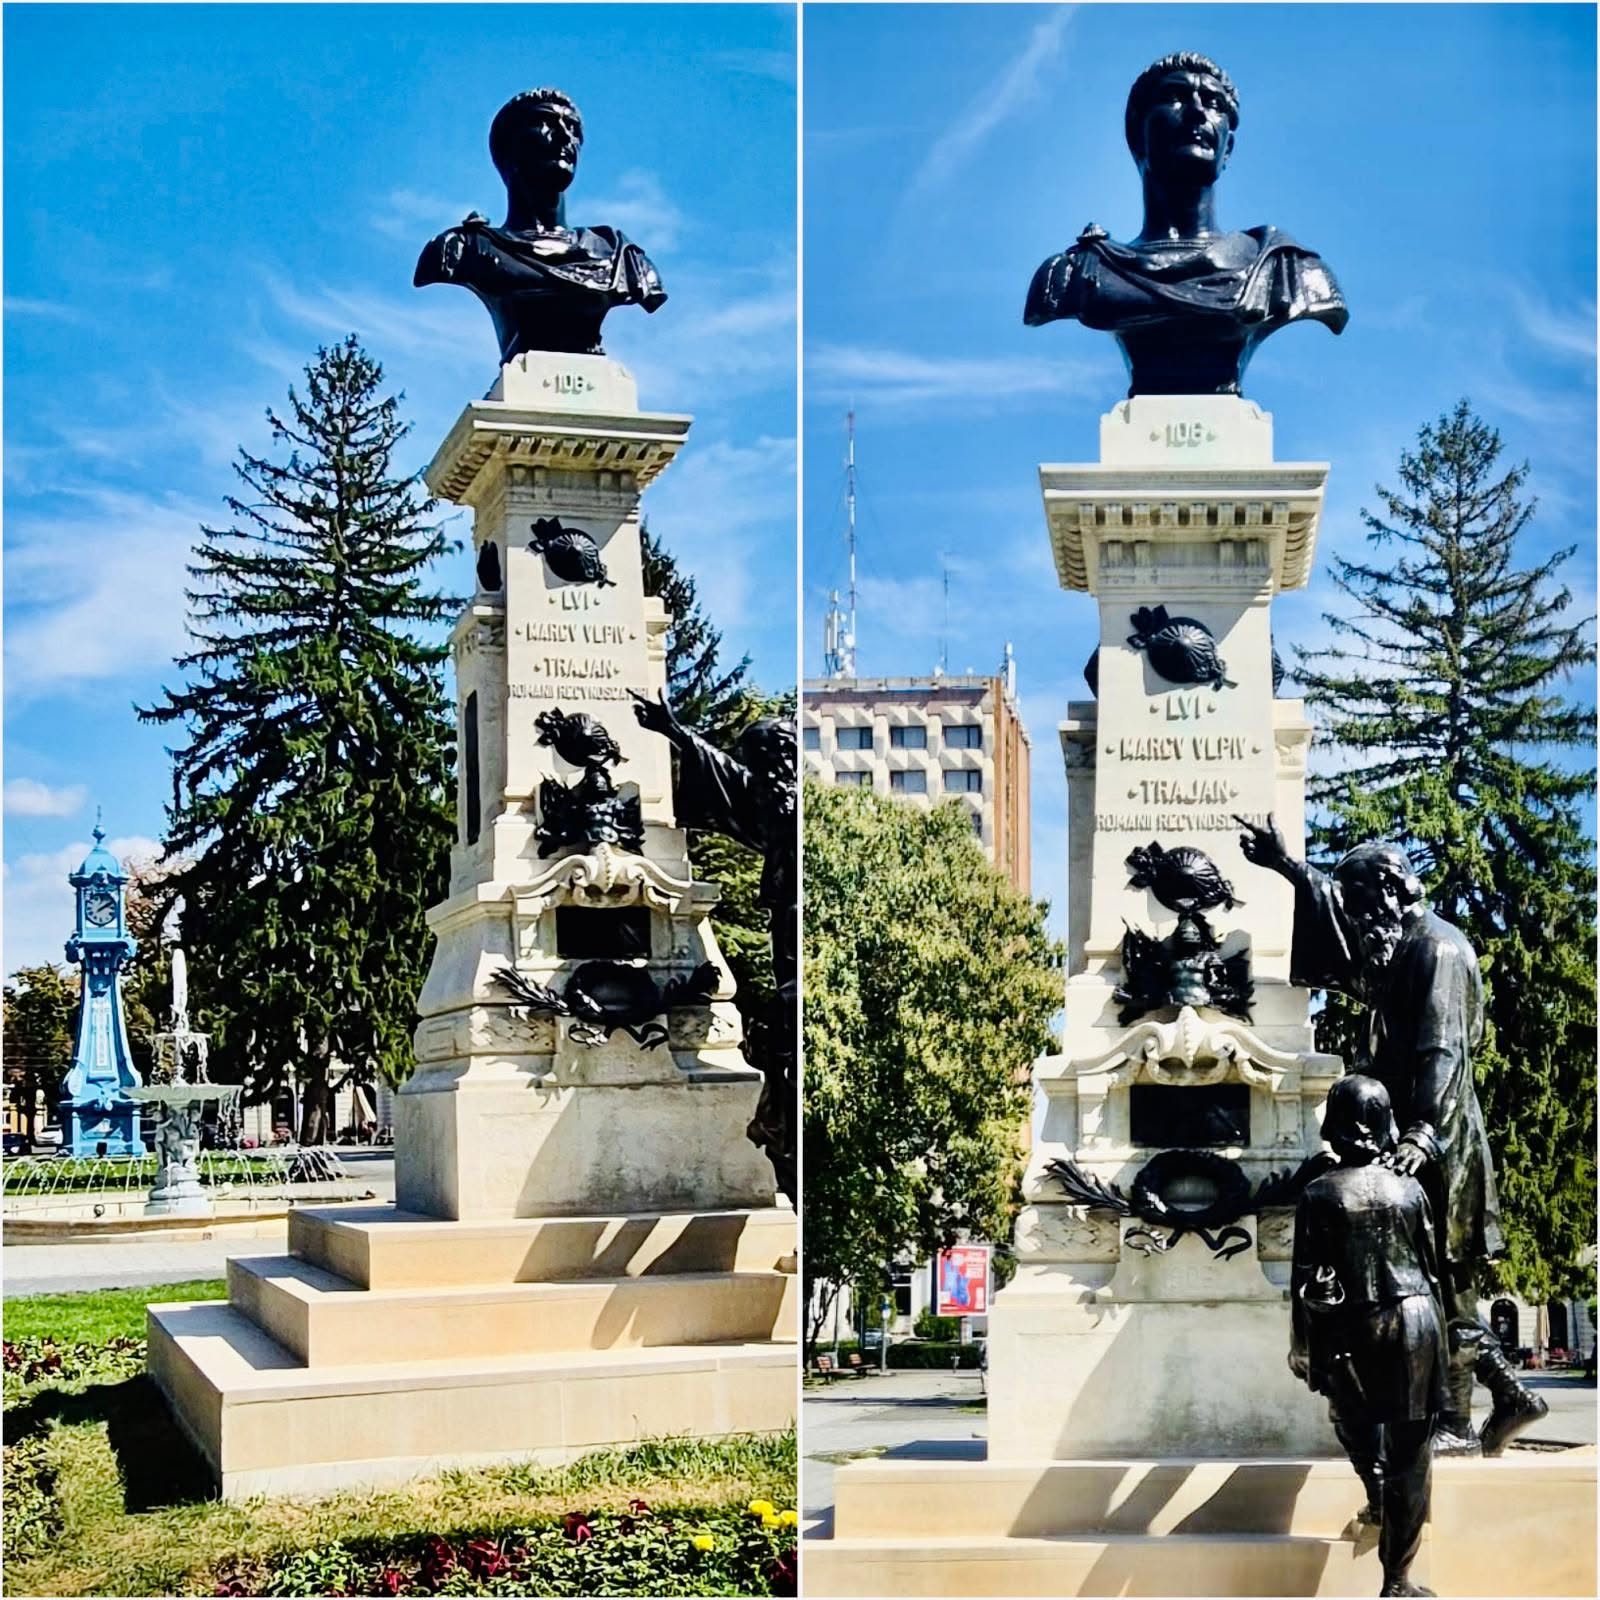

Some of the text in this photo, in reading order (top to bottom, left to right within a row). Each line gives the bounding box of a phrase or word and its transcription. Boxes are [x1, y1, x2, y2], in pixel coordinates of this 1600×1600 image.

[561, 590, 589, 611] LVI
[543, 657, 613, 680] TRAJAN
[1166, 695, 1201, 721] LVI
[1139, 779, 1229, 805] TRAJAN
